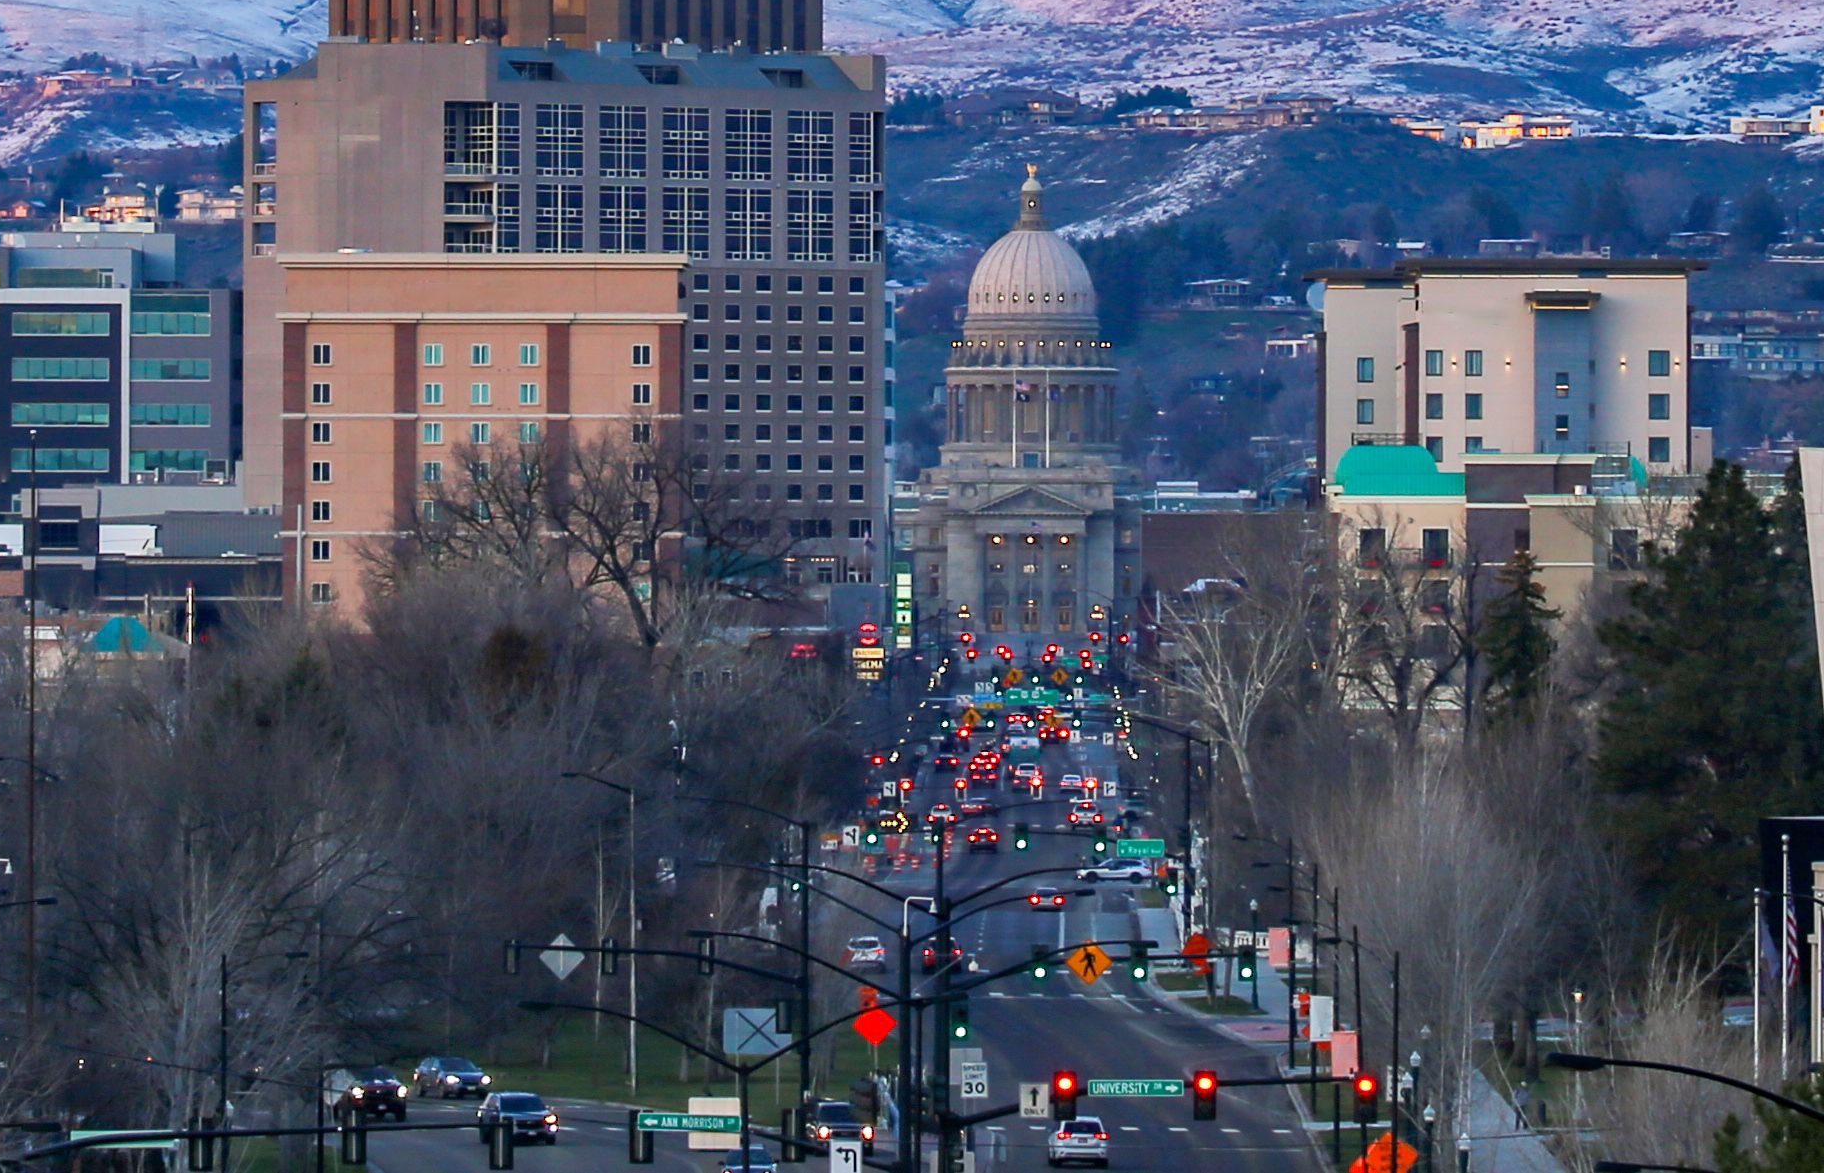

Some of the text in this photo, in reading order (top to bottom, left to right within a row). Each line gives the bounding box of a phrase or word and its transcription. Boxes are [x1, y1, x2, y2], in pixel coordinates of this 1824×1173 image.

[964, 1082, 985, 1094] 30
[1092, 1082, 1150, 1094] UNIVERSITY
[1023, 1107, 1046, 1116] ONLY
[661, 1117, 678, 1127] ANN
[682, 1117, 724, 1128] MORRISON
